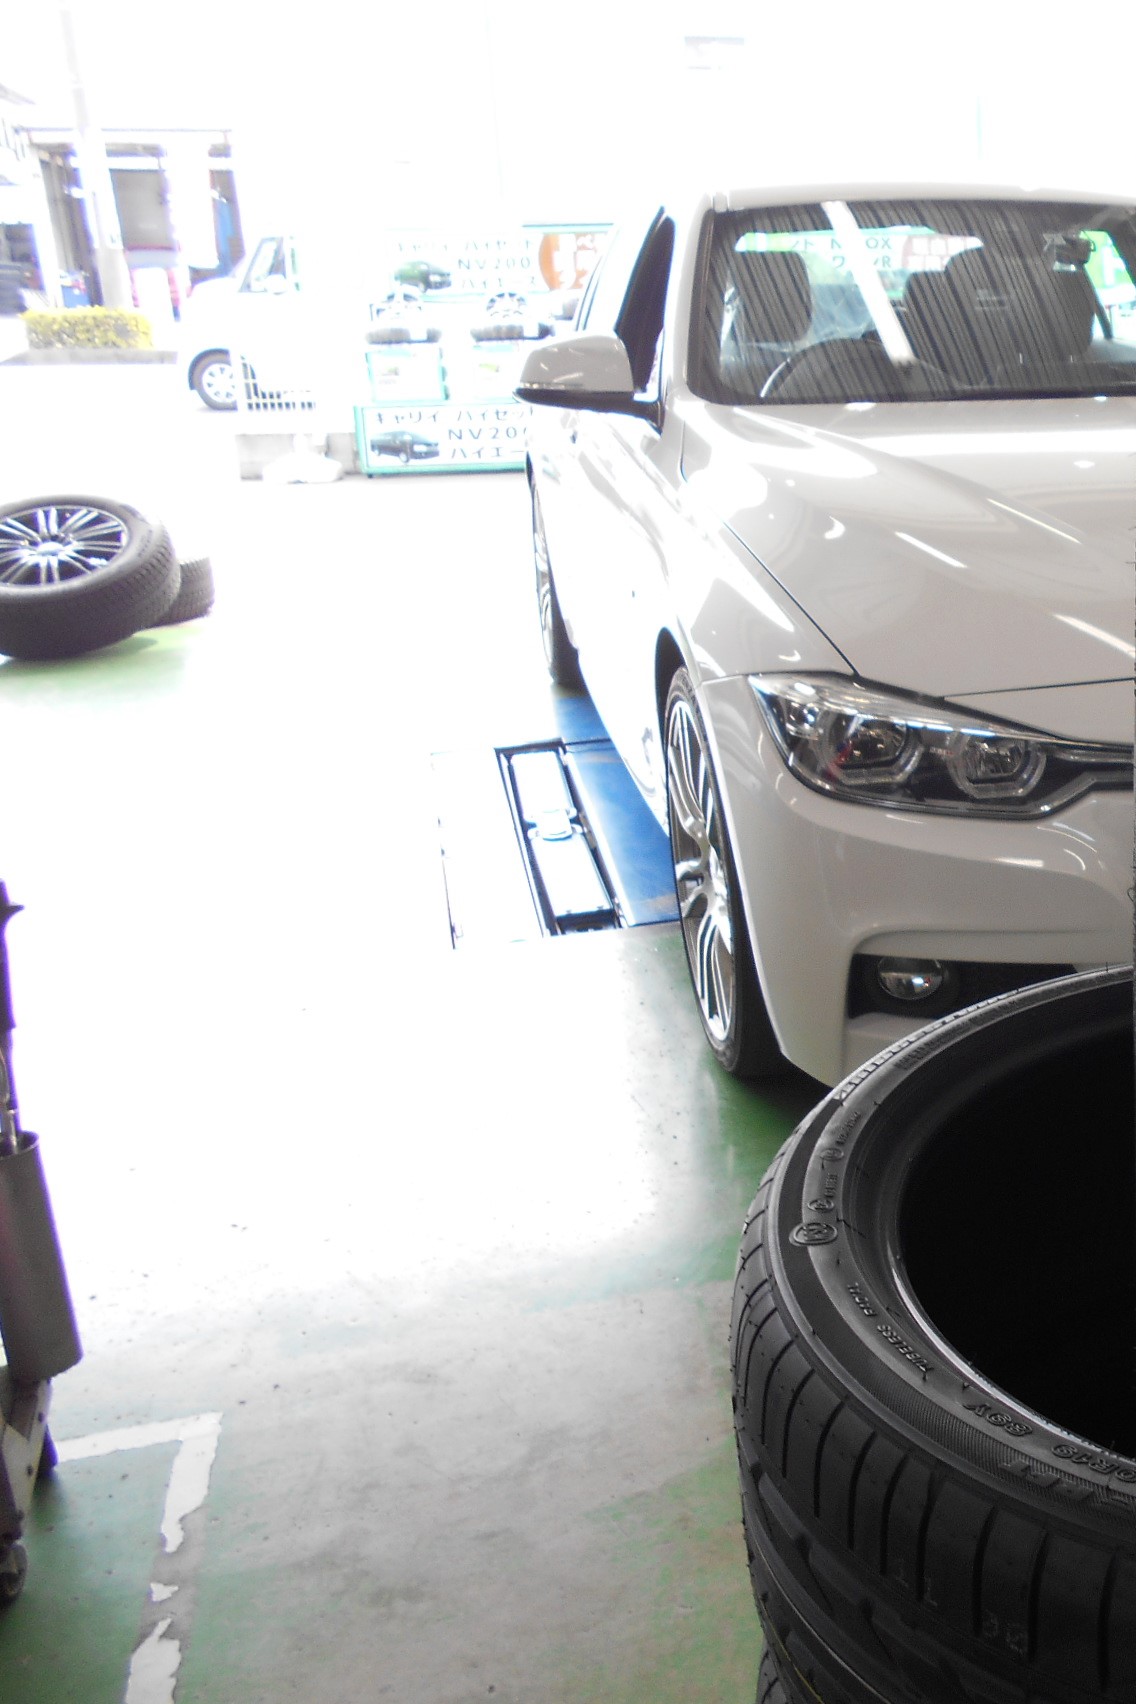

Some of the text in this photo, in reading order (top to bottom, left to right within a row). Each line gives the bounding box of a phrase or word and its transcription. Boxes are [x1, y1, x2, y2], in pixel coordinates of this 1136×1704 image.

[457, 257, 531, 270] NV200
[451, 446, 526, 460] ハイエー
[875, 1322, 931, 1373] TUBELESS
[965, 1402, 1034, 1437] 89Y
